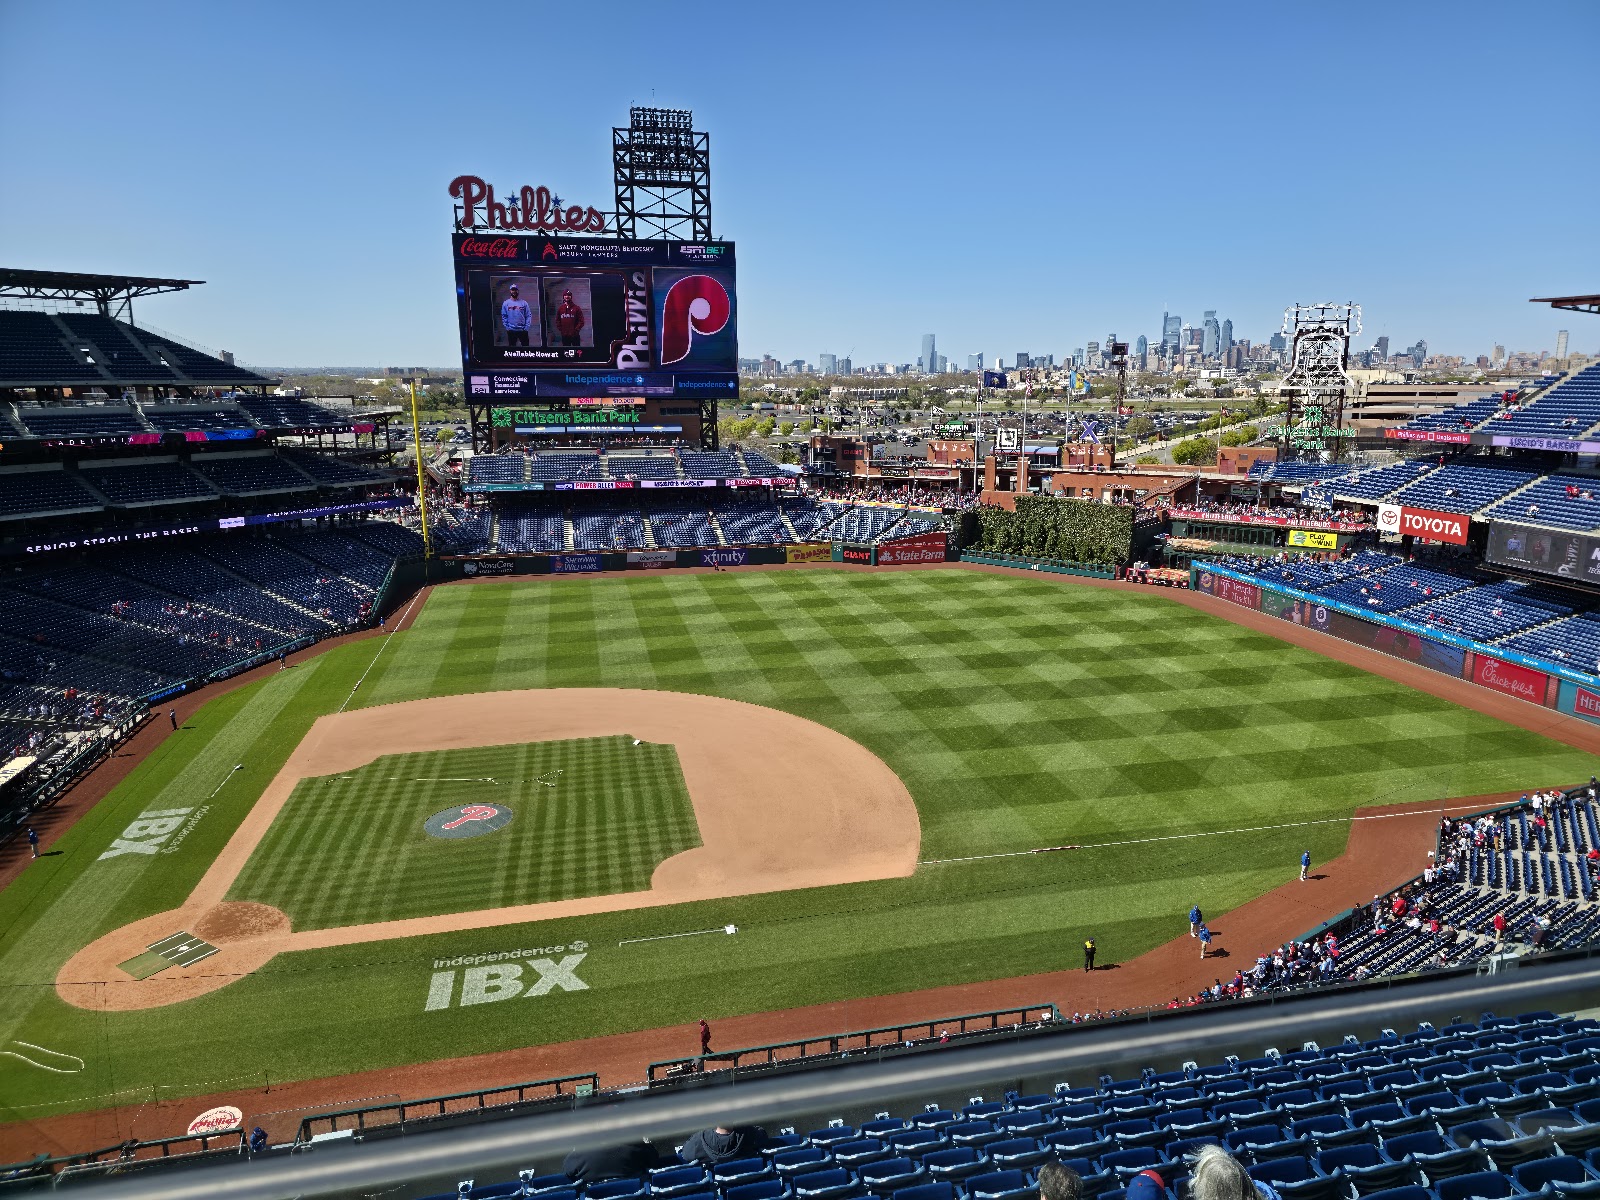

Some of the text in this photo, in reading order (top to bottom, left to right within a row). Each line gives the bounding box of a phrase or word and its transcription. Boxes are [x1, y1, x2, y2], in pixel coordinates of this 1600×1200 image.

[449, 175, 605, 231] Phillies
[706, 246, 725, 255] BET
[565, 374, 633, 385] Independence
[678, 381, 727, 389] Independence
[514, 410, 640, 424] Citizens Bank Park
[1267, 424, 1356, 437] Citizens Bank
[1295, 438, 1325, 449] Park
[1546, 439, 1582, 451] BAKERY
[1404, 514, 1462, 536] TOYOTA
[703, 551, 746, 566] xfinity
[843, 551, 871, 560] GIANT
[894, 549, 945, 561] State Farm
[478, 561, 514, 569] NovaCare
[1482, 664, 1535, 697] Chick-fil-A
[97, 806, 194, 861] IBX
[433, 944, 564, 969] Independence
[424, 953, 590, 1011] IBX
